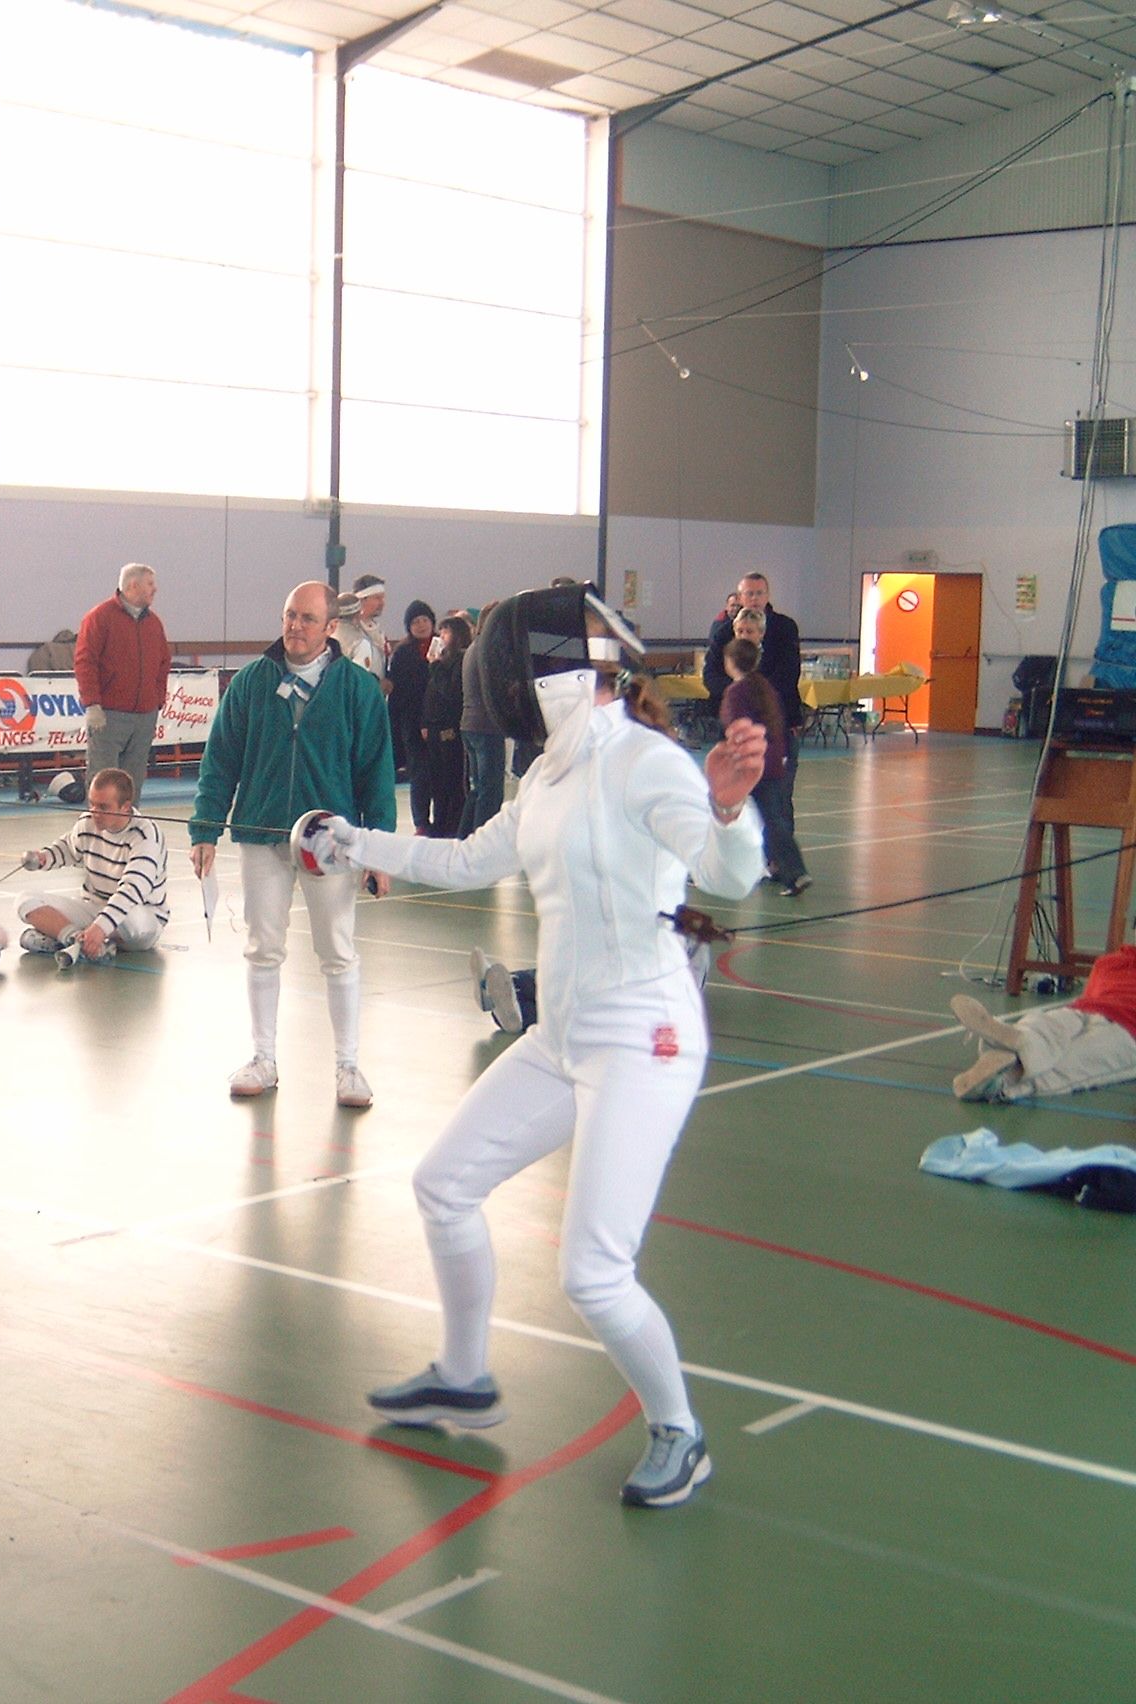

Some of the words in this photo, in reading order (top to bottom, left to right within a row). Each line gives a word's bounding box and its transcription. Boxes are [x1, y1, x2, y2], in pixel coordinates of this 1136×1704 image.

[24, 693, 86, 717] VOYA
[172, 686, 214, 710] Agence
[161, 704, 208, 729] Voyages
